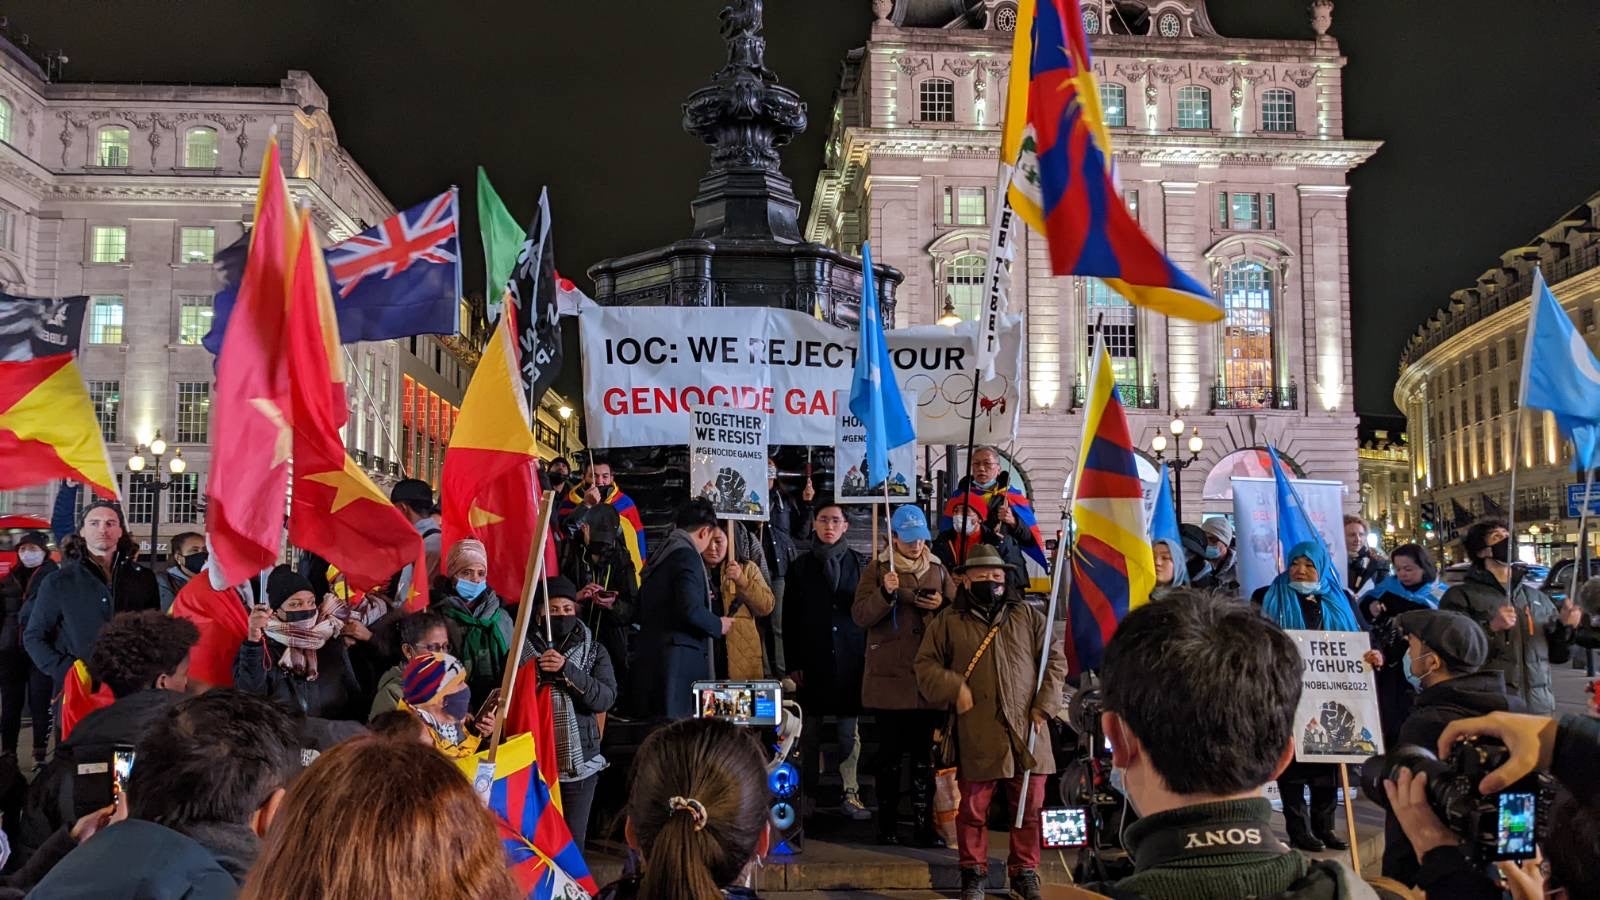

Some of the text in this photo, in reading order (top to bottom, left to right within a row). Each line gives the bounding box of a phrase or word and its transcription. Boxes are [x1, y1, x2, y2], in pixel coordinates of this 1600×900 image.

[987, 257, 1003, 352] TIBET
[605, 336, 966, 370] IOC: WE REJECT OUR
[603, 385, 836, 416] GENOCIDE GA
[694, 411, 761, 429] TOGETHER
[695, 427, 761, 445] WE RESIST
[695, 446, 762, 459] #GENOCIDEGAMES
[1310, 641, 1347, 657] FREE
[1301, 681, 1368, 691] NOBEIJING2022
[1184, 828, 1262, 849] SONY
